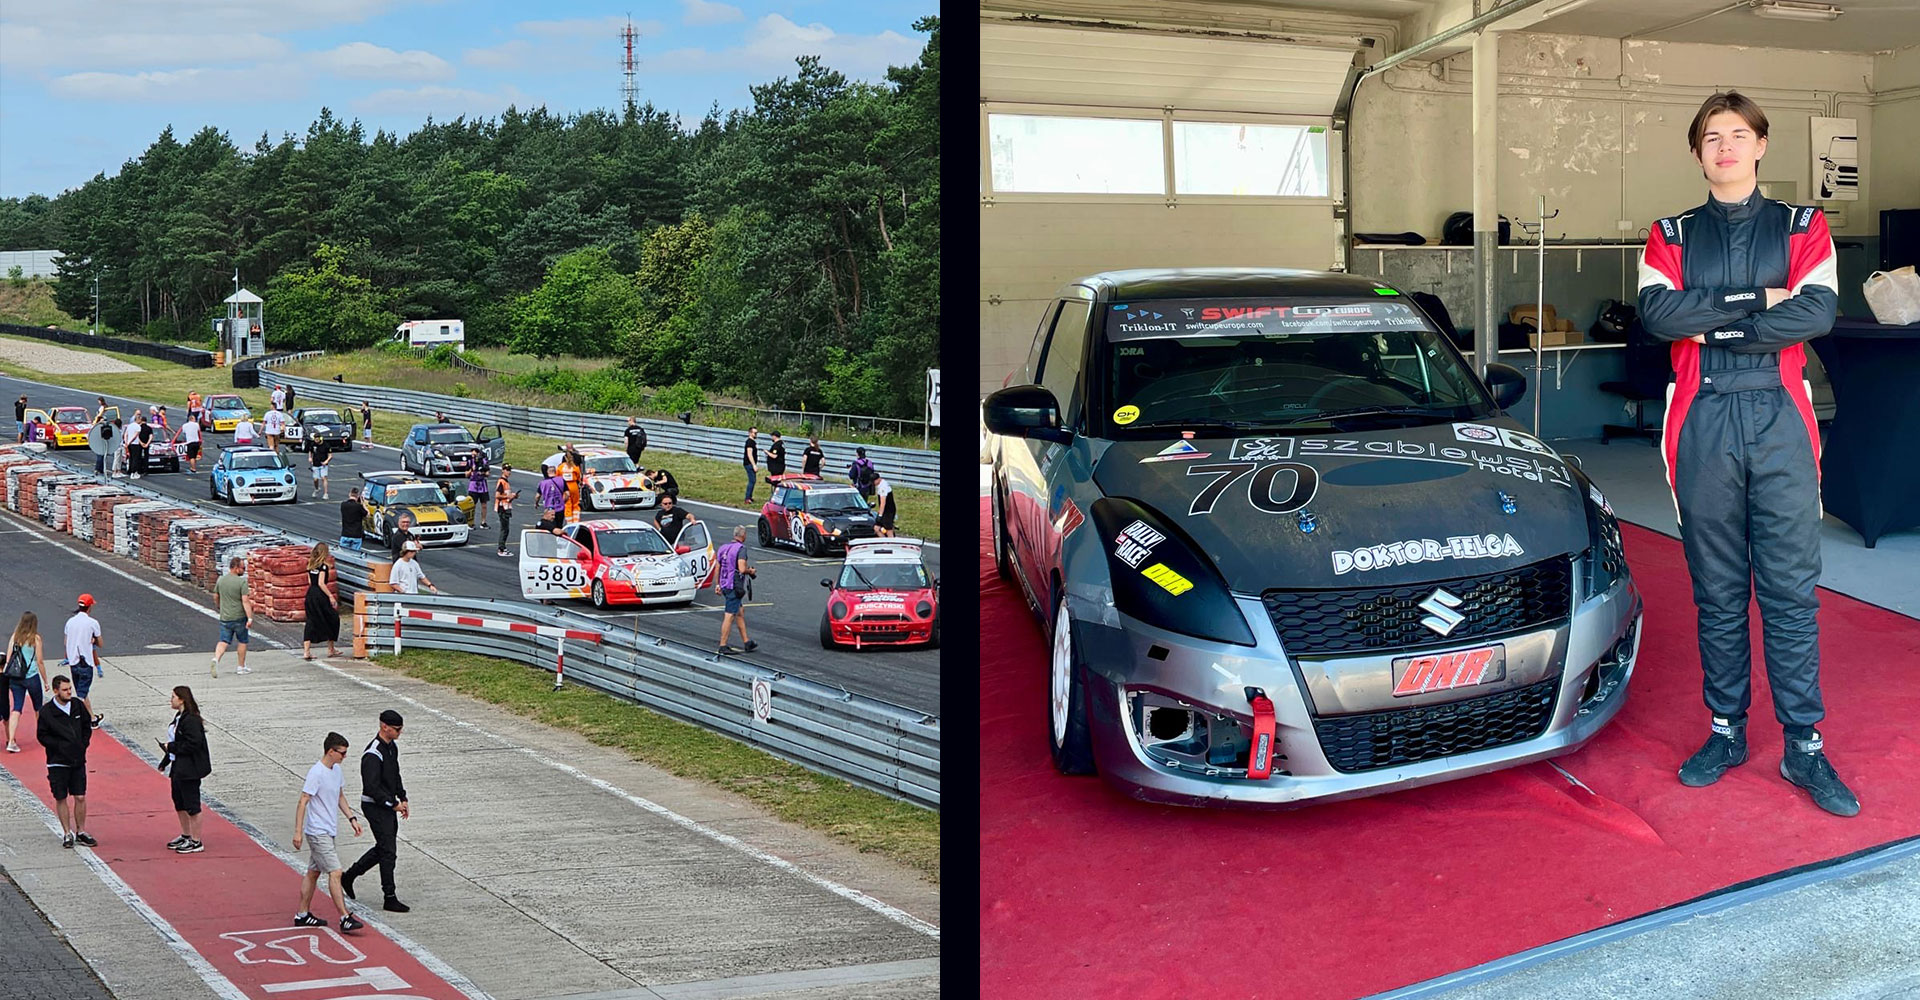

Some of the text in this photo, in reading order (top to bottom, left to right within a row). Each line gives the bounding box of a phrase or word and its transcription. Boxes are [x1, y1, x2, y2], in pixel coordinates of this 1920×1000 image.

[1724, 292, 1756, 302] sparco
[1201, 307, 1291, 320] SWIFT
[1334, 306, 1372, 314] EUROPE
[1185, 322, 1265, 330] swiftcupeurope.com
[1281, 319, 1381, 328] facebook.com/swiftcupeurope
[1385, 317, 1424, 326] Triklon-IT
[1119, 323, 1177, 332] Triklon-IT
[1714, 331, 1744, 340] sparco
[288, 427, 299, 437] 81
[1186, 462, 1320, 516] 70
[1123, 521, 1164, 548] RALLY
[1116, 538, 1149, 566] RACE
[1331, 533, 1525, 576] DOKTOR-FELGA
[538, 564, 578, 583] 580
